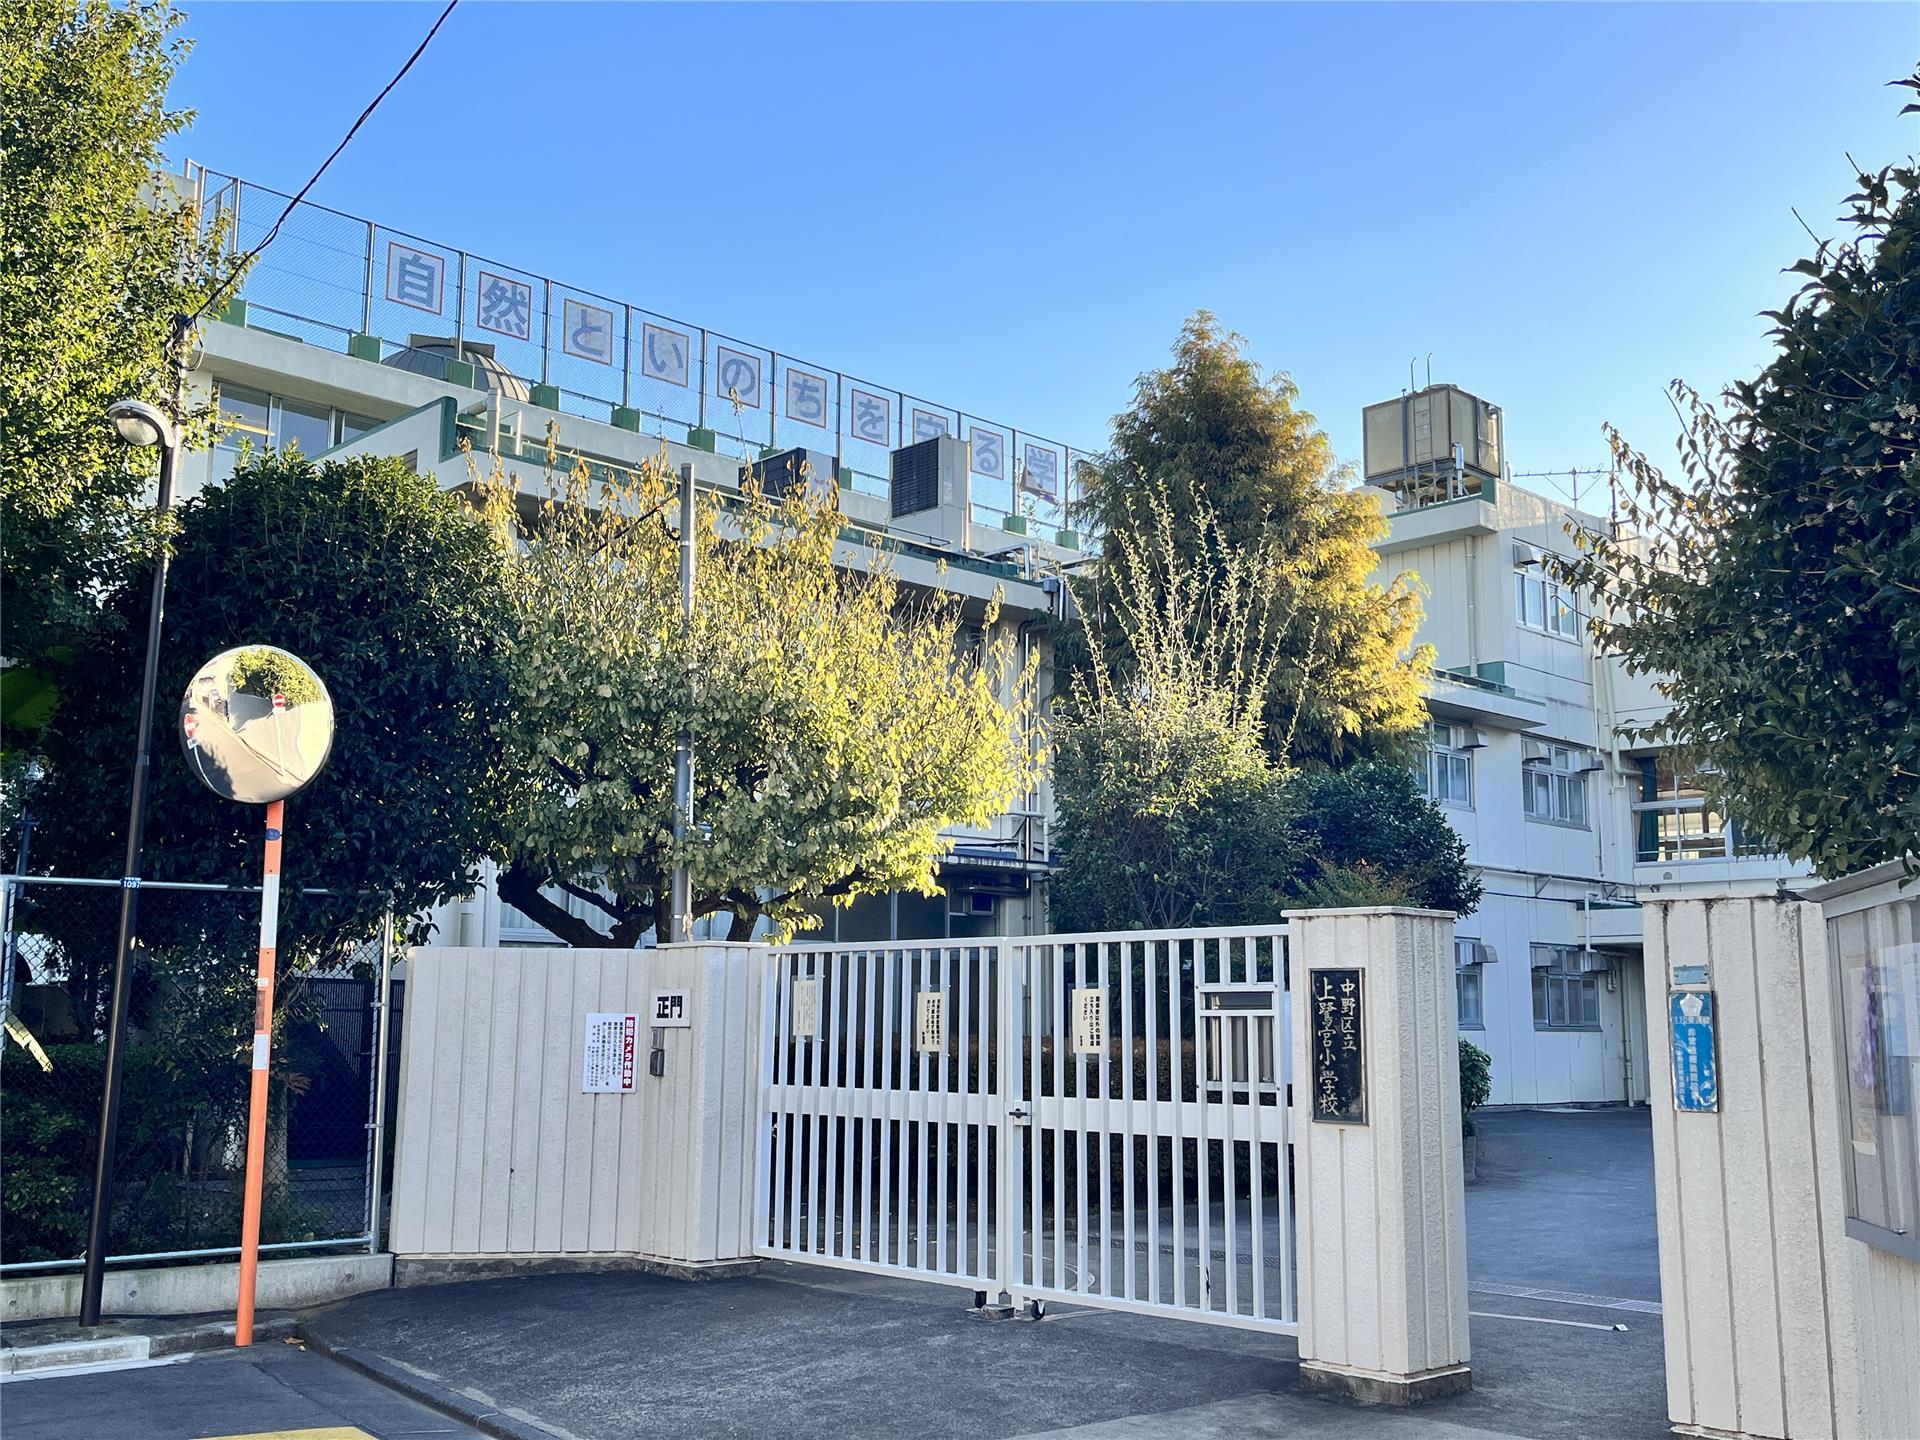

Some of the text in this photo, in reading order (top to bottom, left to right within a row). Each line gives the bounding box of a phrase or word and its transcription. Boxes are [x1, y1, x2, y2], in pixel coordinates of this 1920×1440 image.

[656, 995, 683, 1019] 正門
[1340, 978, 1357, 1052] 中野区立
[1317, 976, 1340, 1116] 上鷺宮小学校
